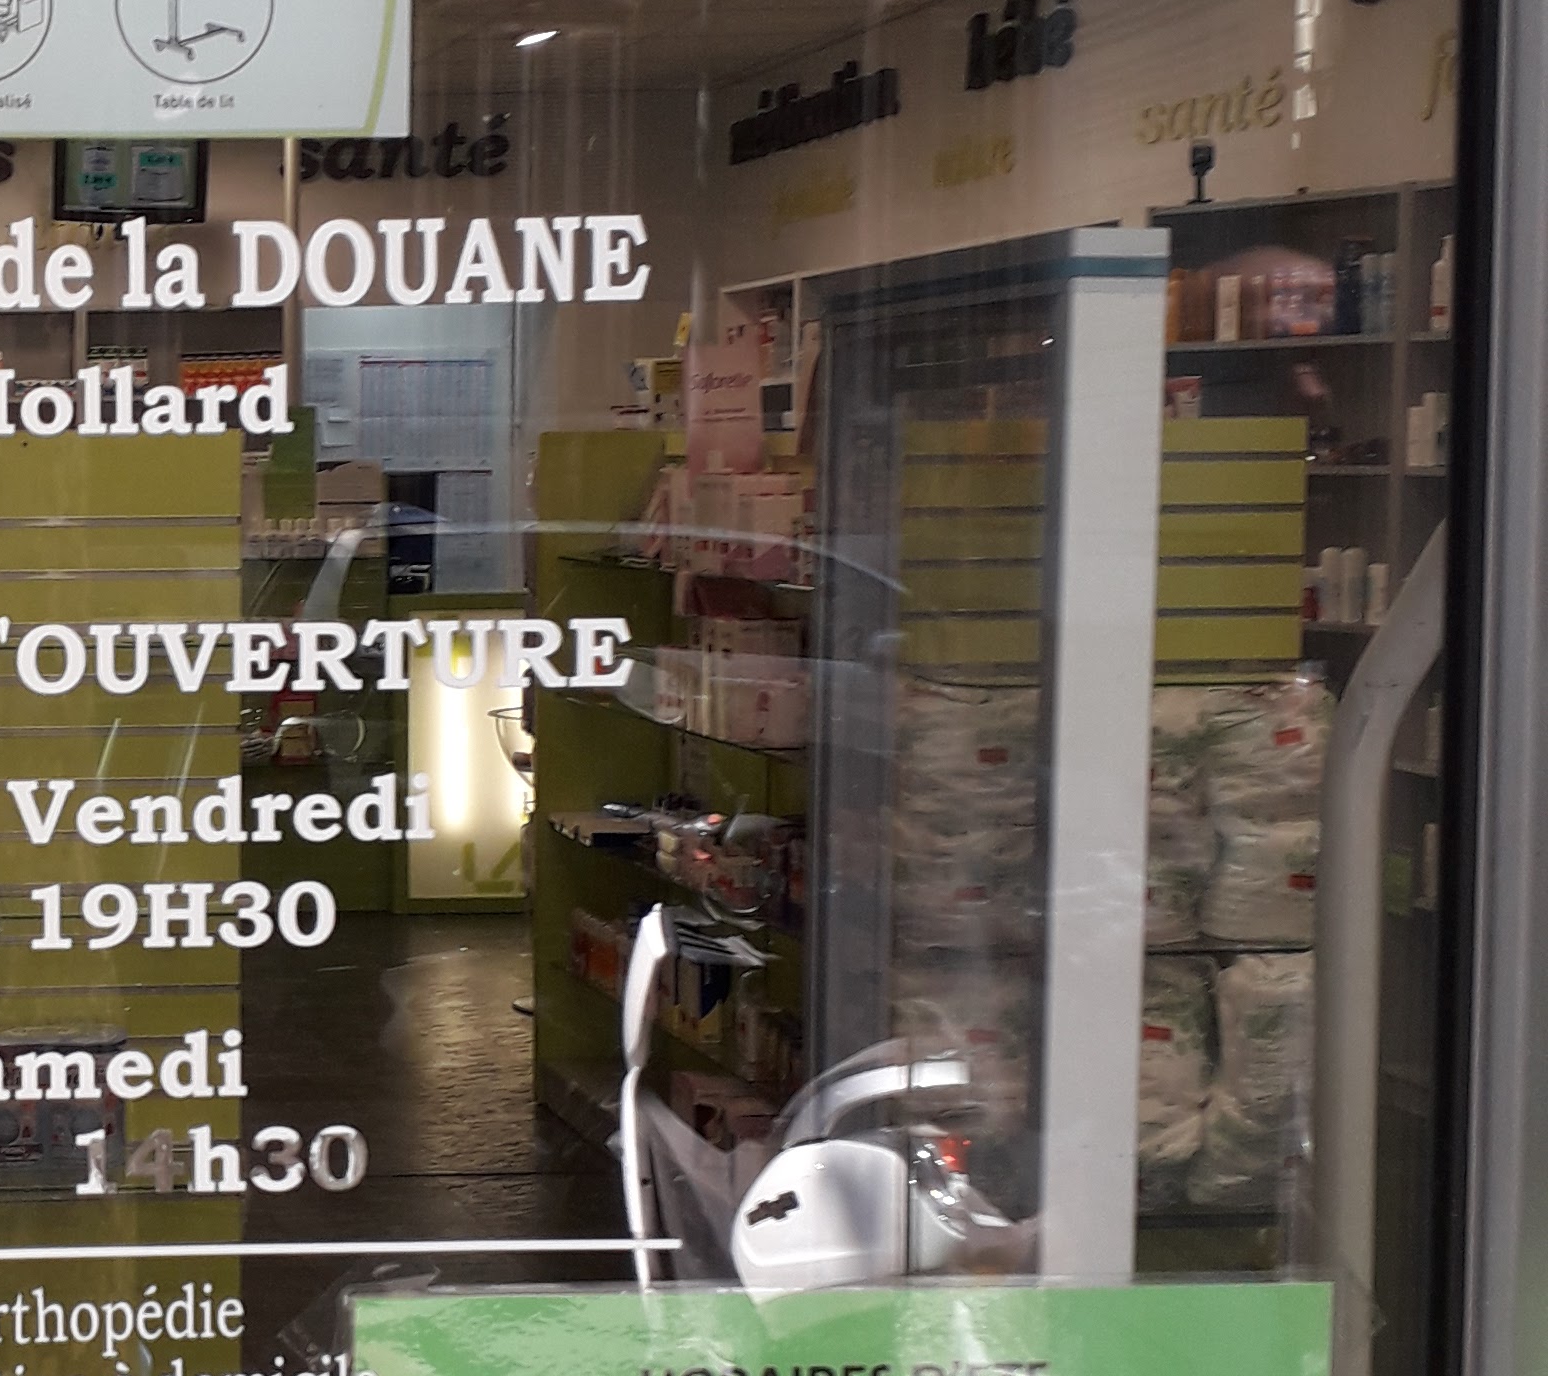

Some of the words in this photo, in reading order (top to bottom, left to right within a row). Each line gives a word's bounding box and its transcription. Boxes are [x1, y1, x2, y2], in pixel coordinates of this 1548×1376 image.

[154, 92, 192, 110] Table
[196, 93, 217, 110] de
[121, 216, 205, 309] la
[231, 213, 651, 308] DOUANE
[14, 772, 435, 849] Vendredi
[28, 877, 337, 953] 19H30
